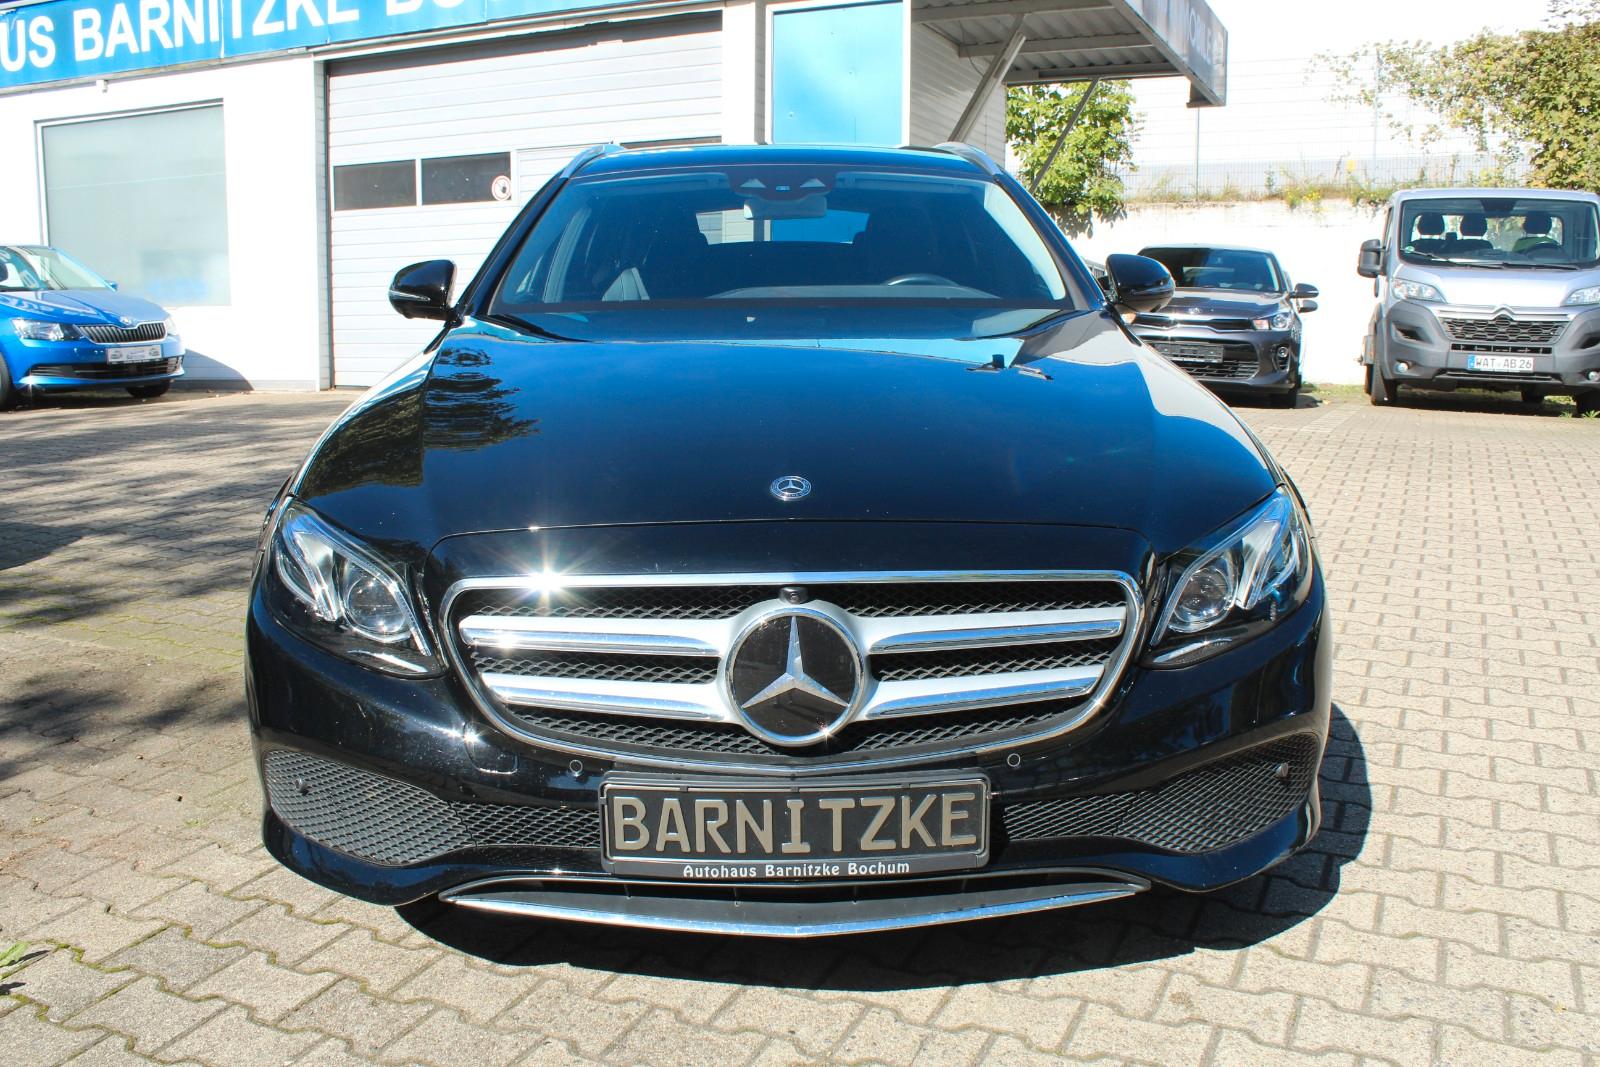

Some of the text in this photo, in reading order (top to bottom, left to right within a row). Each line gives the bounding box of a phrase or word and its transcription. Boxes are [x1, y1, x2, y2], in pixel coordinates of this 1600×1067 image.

[613, 793, 976, 853] BARNITZKE
[683, 861, 910, 878] Autohaus Barnitzke Bochum
